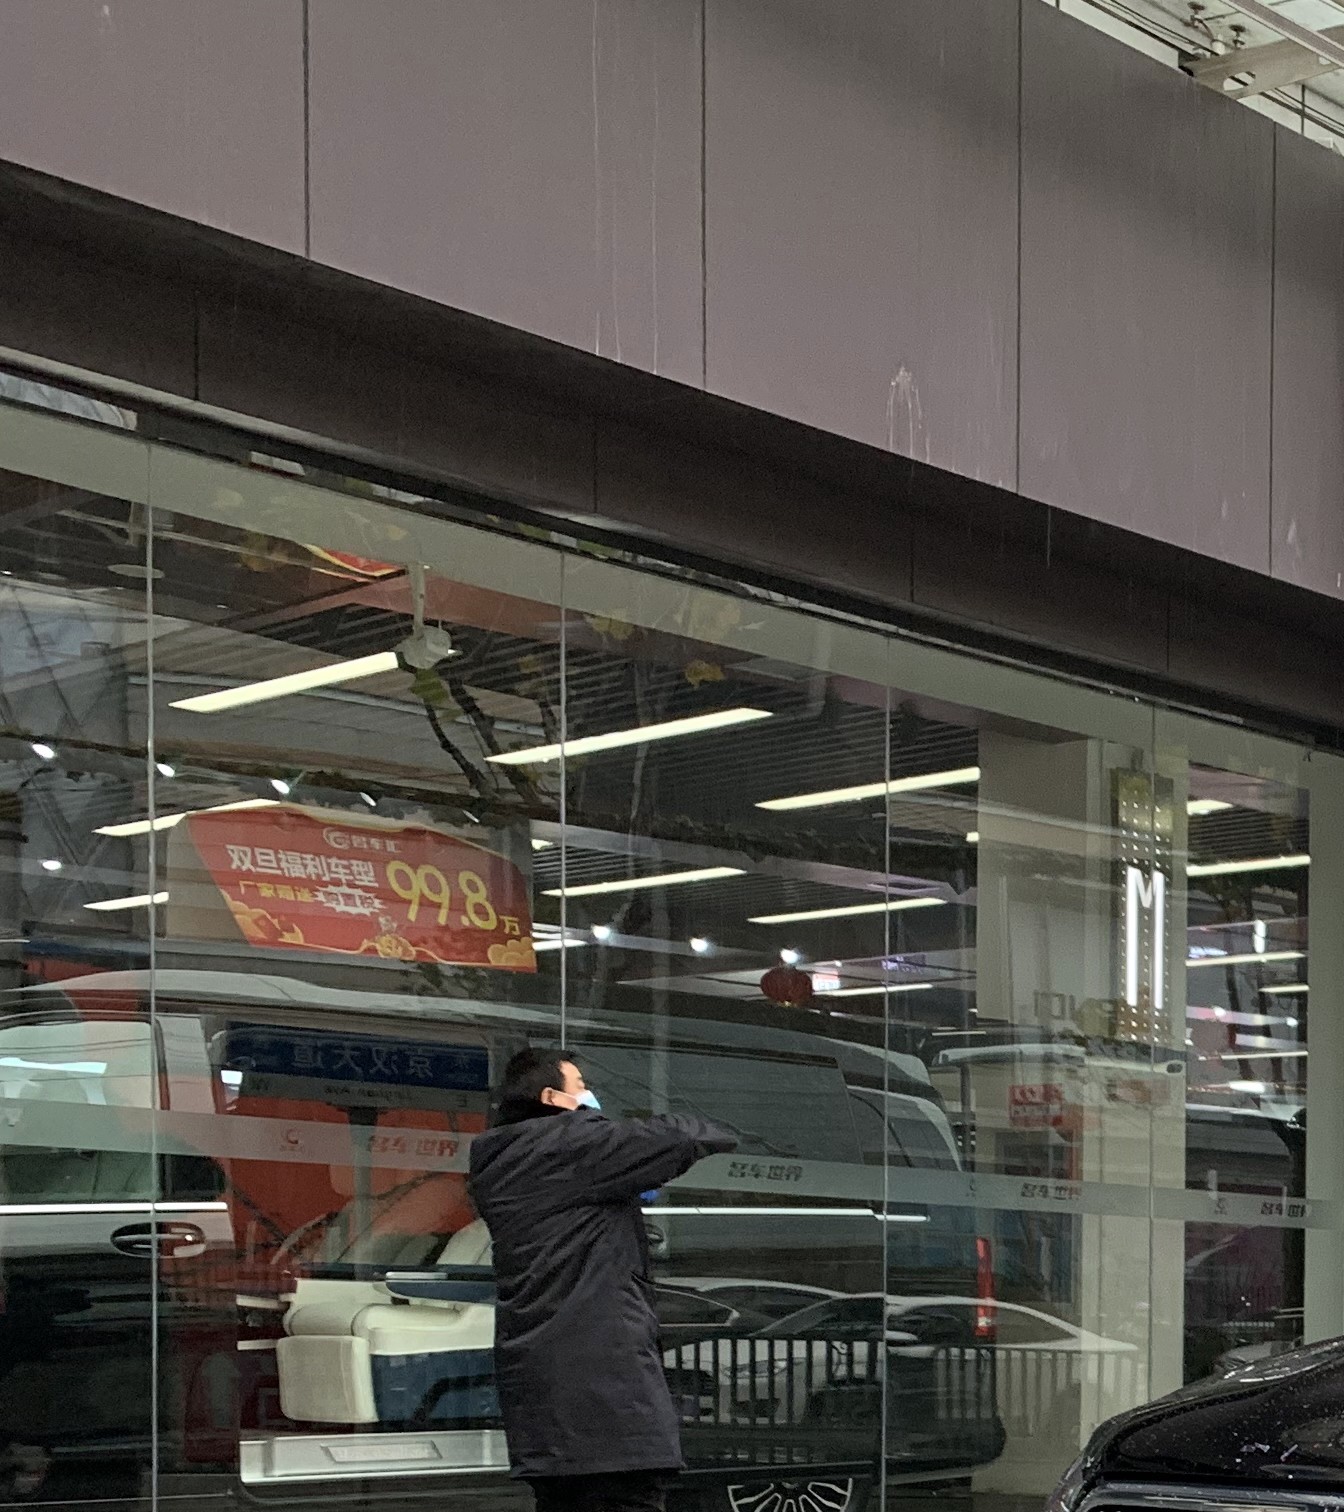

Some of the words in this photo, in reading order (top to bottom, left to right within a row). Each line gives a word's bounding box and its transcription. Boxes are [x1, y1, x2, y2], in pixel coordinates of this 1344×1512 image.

[226, 844, 379, 887] 双旦福利车型
